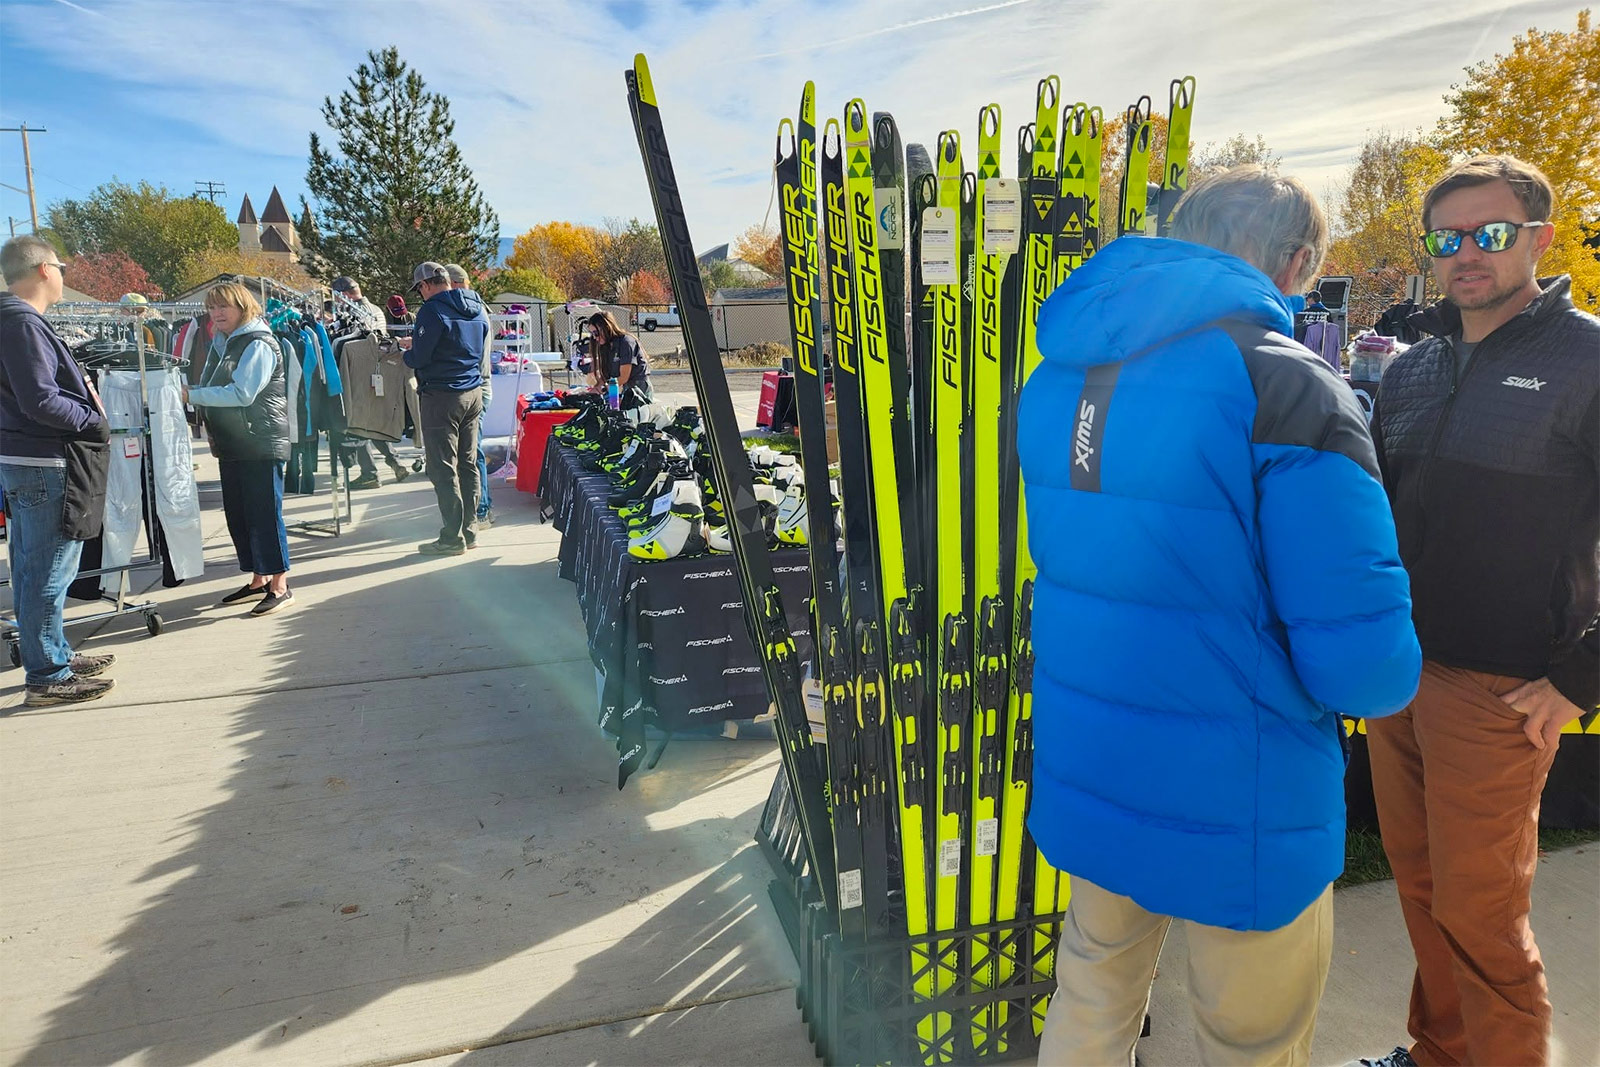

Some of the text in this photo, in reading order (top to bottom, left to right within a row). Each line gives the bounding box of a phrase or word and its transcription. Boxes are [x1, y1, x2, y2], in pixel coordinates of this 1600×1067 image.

[783, 183, 817, 377] FISCHER
[826, 182, 856, 375] FISCHER
[854, 191, 885, 365] FISCHER
[683, 570, 726, 580] FISCHER
[720, 601, 743, 610] FISC
[685, 637, 727, 648] FISCHER
[721, 666, 761, 676] FISCHER
[46, 685, 77, 694] HOKA
[688, 702, 728, 715] FISCHER
